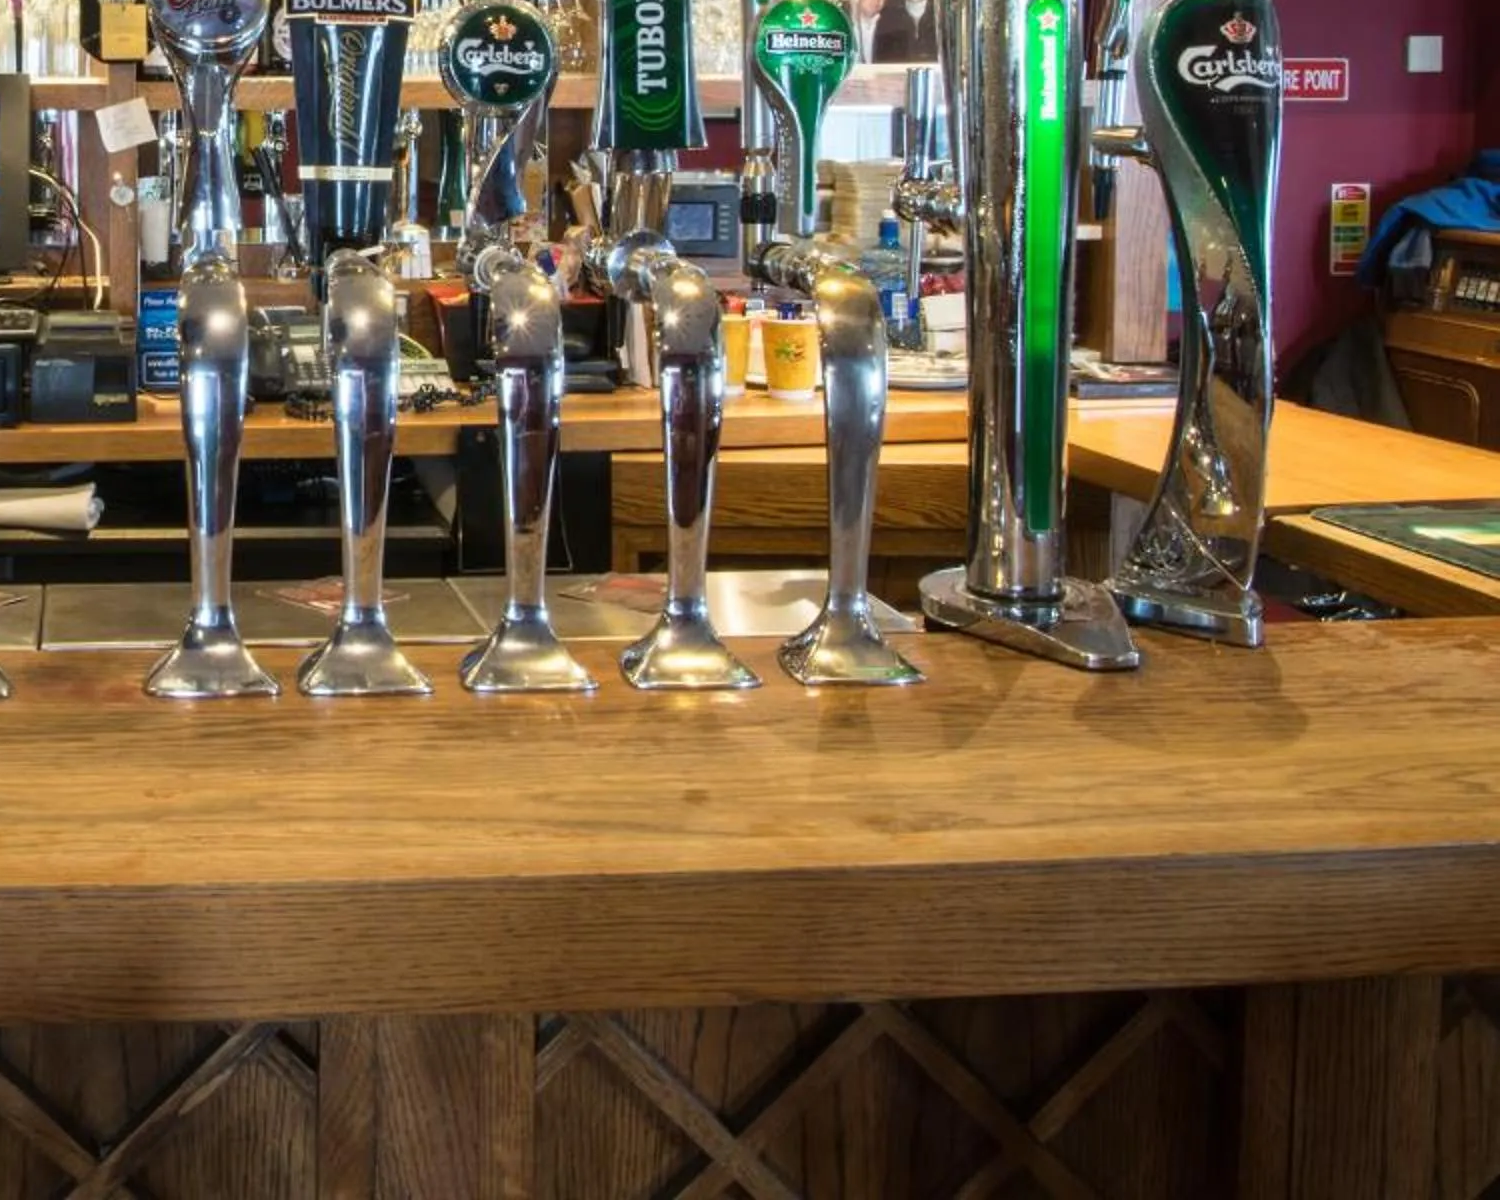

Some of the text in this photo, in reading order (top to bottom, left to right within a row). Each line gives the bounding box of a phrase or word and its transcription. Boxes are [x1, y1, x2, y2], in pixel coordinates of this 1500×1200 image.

[770, 33, 843, 50] Heineken
[455, 37, 546, 76] Carlsberg
[1303, 69, 1342, 91] POINT
